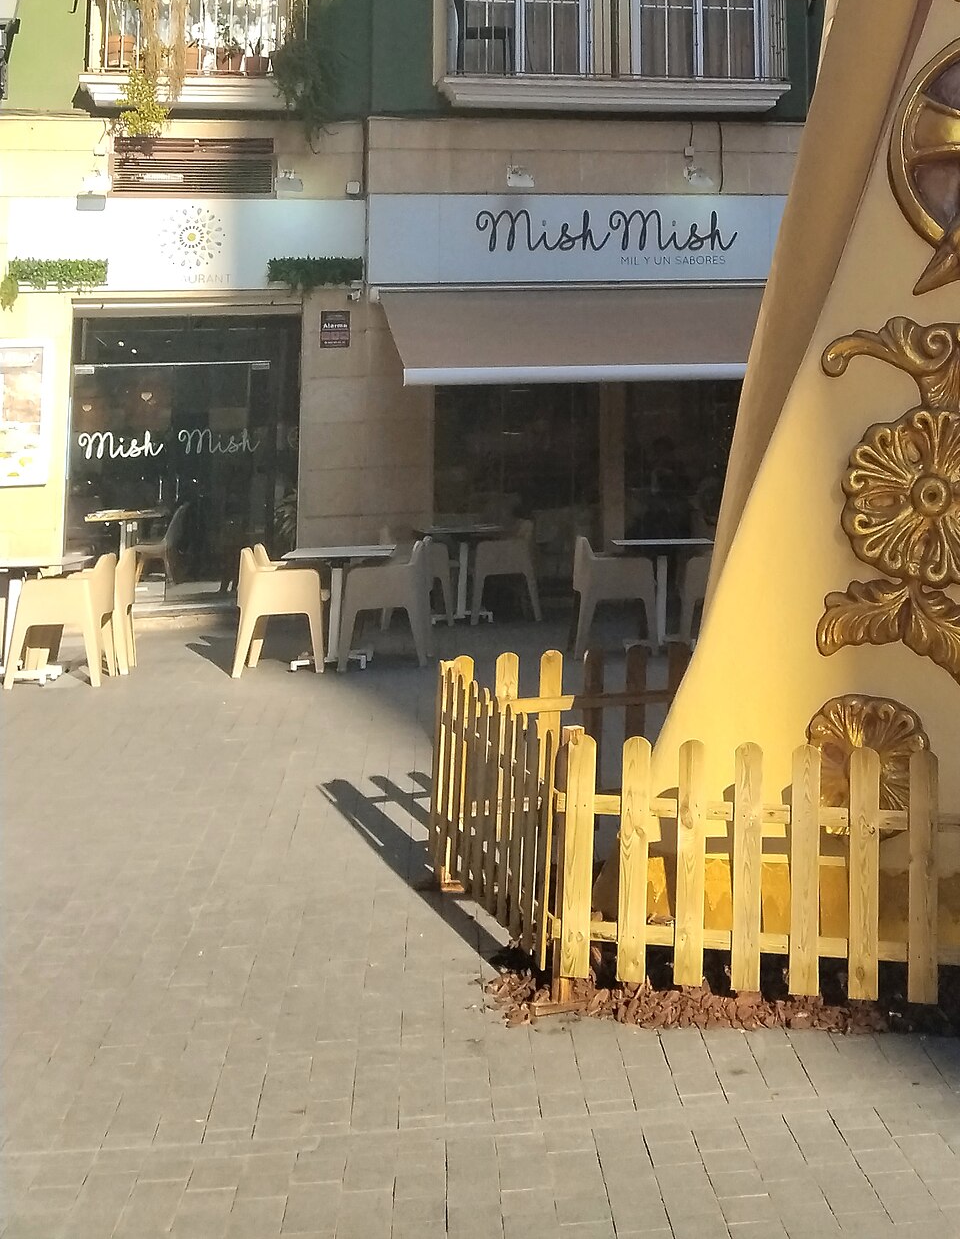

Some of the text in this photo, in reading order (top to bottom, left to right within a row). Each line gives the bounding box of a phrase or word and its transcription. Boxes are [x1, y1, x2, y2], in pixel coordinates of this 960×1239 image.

[620, 255, 726, 266] MIL Y UN SABORES
[78, 428, 261, 459] Mish Mish
